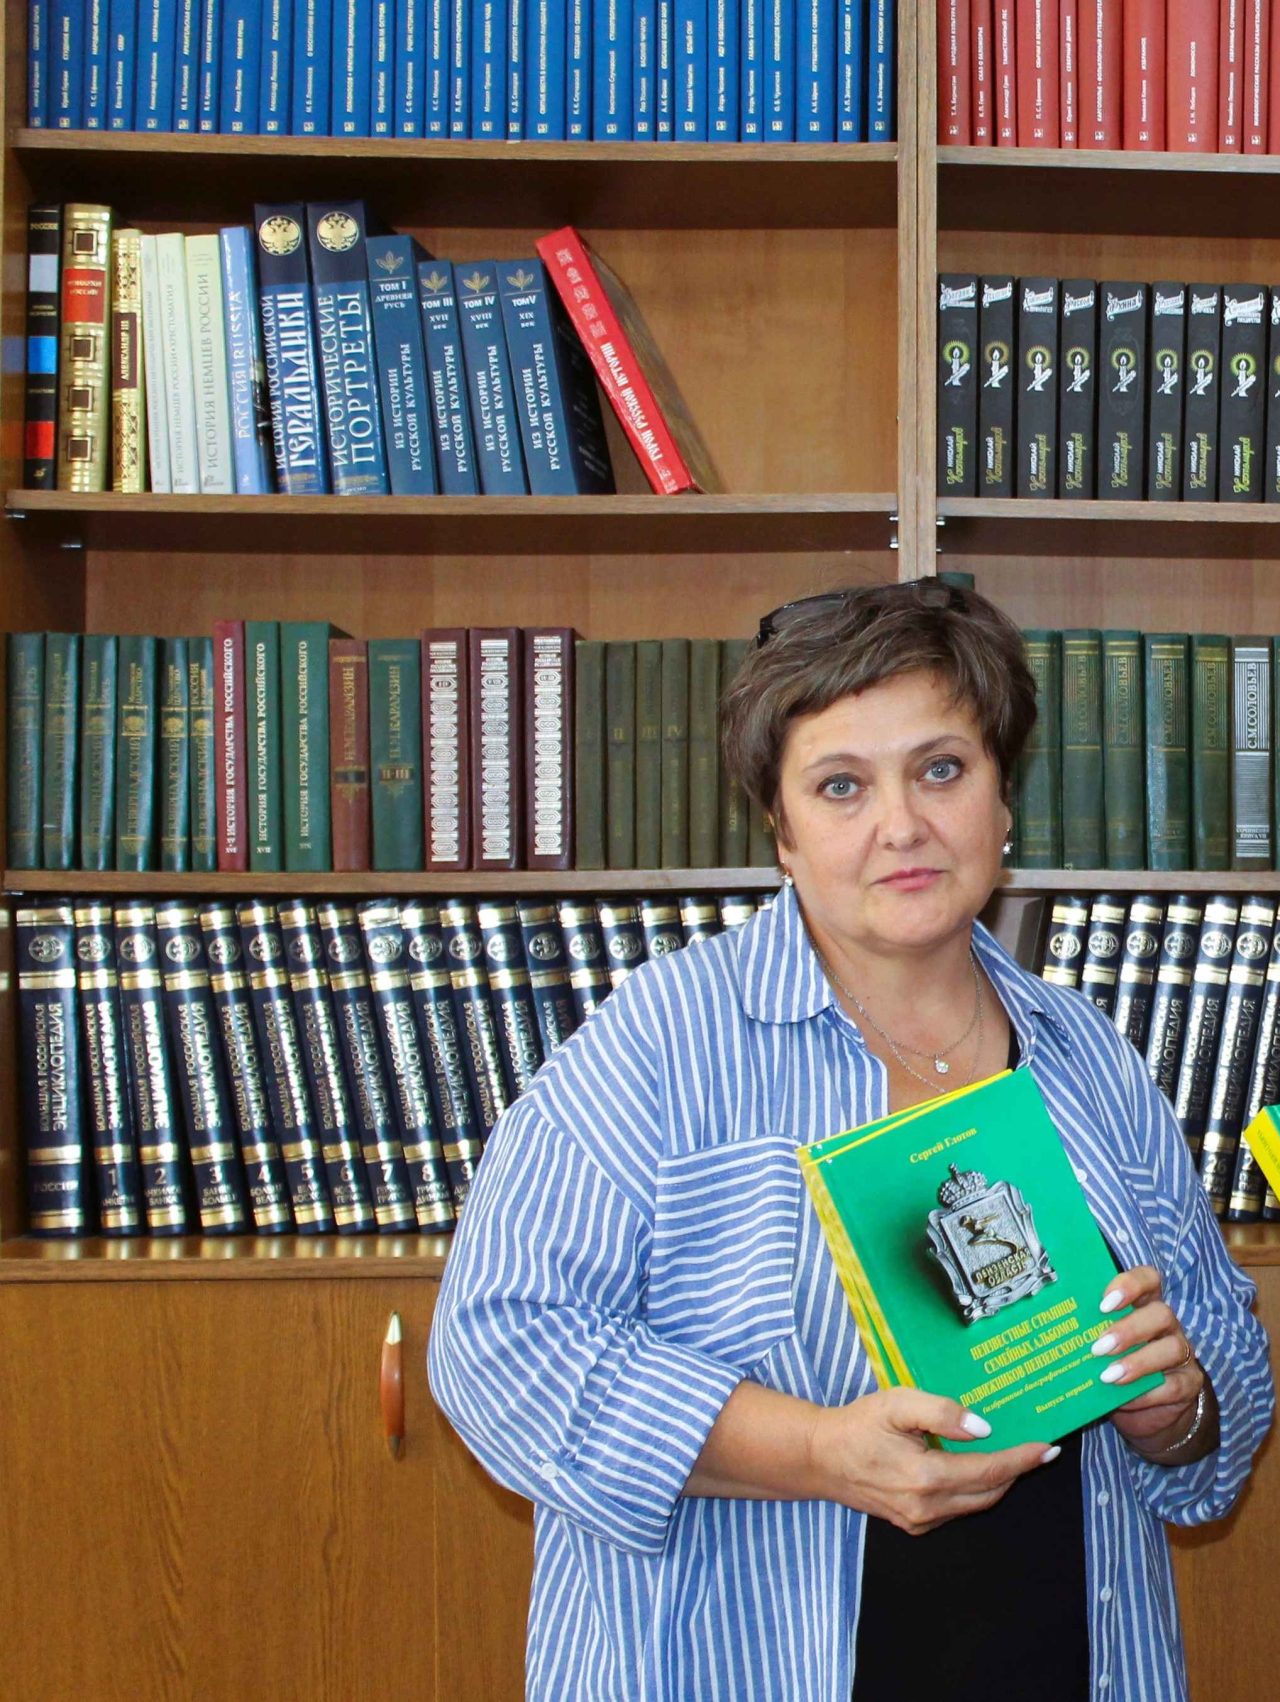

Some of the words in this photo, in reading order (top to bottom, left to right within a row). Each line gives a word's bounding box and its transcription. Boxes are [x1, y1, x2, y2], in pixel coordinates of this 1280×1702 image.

[196, 273, 210, 332] РОССИИ
[379, 284, 399, 292] ТОМ
[422, 301, 441, 310] ТОМ
[442, 296, 454, 306] III
[464, 300, 482, 309] ТОМ
[484, 296, 496, 306] IV
[200, 337, 214, 395] НЕМЦЕВ
[276, 292, 315, 467] ГЕРАЛЬДИКИ
[317, 295, 349, 466] ИСТОРИЧЕСКИЕ
[337, 292, 375, 463] ПОРТРЕТЫ
[400, 343, 415, 407] КУЛЬТУРЫ
[444, 344, 460, 408] КУЛЬТУРЫ
[487, 345, 503, 409] КУЛЬТУРЫ
[533, 342, 550, 407] КУЛЬТУРЫ
[234, 370, 250, 438] РОССИЯ
[388, 368, 402, 426] ИСТОРИИ
[432, 369, 448, 428] ИСТОРИИ
[476, 370, 492, 428] ИСТОРИИ
[522, 367, 539, 426] ИСТОРИИ
[203, 400, 218, 468] ИСТОРИЯ
[270, 400, 287, 468] ИСТОРИЯ
[394, 432, 404, 448] ИЗ
[406, 413, 421, 470] РУССКОЙ
[439, 434, 450, 450] ИЗ
[451, 414, 467, 472] РУССКОЙ
[484, 434, 495, 450] ИЗ
[495, 414, 511, 472] РУССКОЙ
[531, 431, 542, 448] ИЗ
[542, 412, 559, 470] РУССКОЙ
[222, 638, 232, 711] РОССИЙСКОГО
[255, 643, 265, 716] РОССИЙСКОГО
[297, 641, 307, 713] РОССИЙСКОГО
[225, 715, 235, 784] ГОСУДАРСТВА
[257, 720, 267, 790] ГОСУДАРСТВА
[299, 718, 308, 785] ГОСУДАРСТВА
[226, 788, 235, 835] ИСТОРИЯ
[258, 793, 267, 840] ИСТОРИЯ
[300, 790, 308, 836] ИСТОРИЯ
[34, 1004, 46, 1075] РОССИЙСКАЯ
[48, 1003, 67, 1130] ЭНЦИКЛОПЕДИЯ
[177, 1004, 195, 1075] РОССИЙСКАЯ
[221, 1005, 241, 1076] РОССИЙСКАЯ
[233, 1002, 267, 1129] ЭНЦИКЛОПЕДИЯ
[342, 1003, 363, 1075] РОССИЙСКАЯ
[356, 1000, 390, 1127] ЭНЦИКЛОПЕДИЯ
[423, 1002, 444, 1074] РОССИЙСКАЯ
[435, 999, 471, 1126] ЭНЦИКЛОПЕДИЯ
[38, 1080, 49, 1131] БОЛЬШАЯ
[189, 1078, 204, 1130] БОЛЬШАЯ
[234, 1079, 251, 1131] БОЛЬШАЯ
[357, 1078, 374, 1129] БОЛЬШАЯ
[438, 1076, 454, 1128] БОЛЬШАЯ
[210, 1165, 222, 1184] 3
[258, 1165, 270, 1183] 4
[381, 1163, 394, 1182] 7
[910, 1142, 944, 1164] Сергей
[944, 1128, 977, 1148] Глотов
[970, 1320, 1032, 1361] НЕИЗВЕСТНЫЕ
[1031, 1296, 1078, 1329] СТРАНИЦЫ
[984, 1340, 1034, 1375] СЕМЕЙНЫХ
[1034, 1317, 1079, 1348] АЛЬБОМОВ
